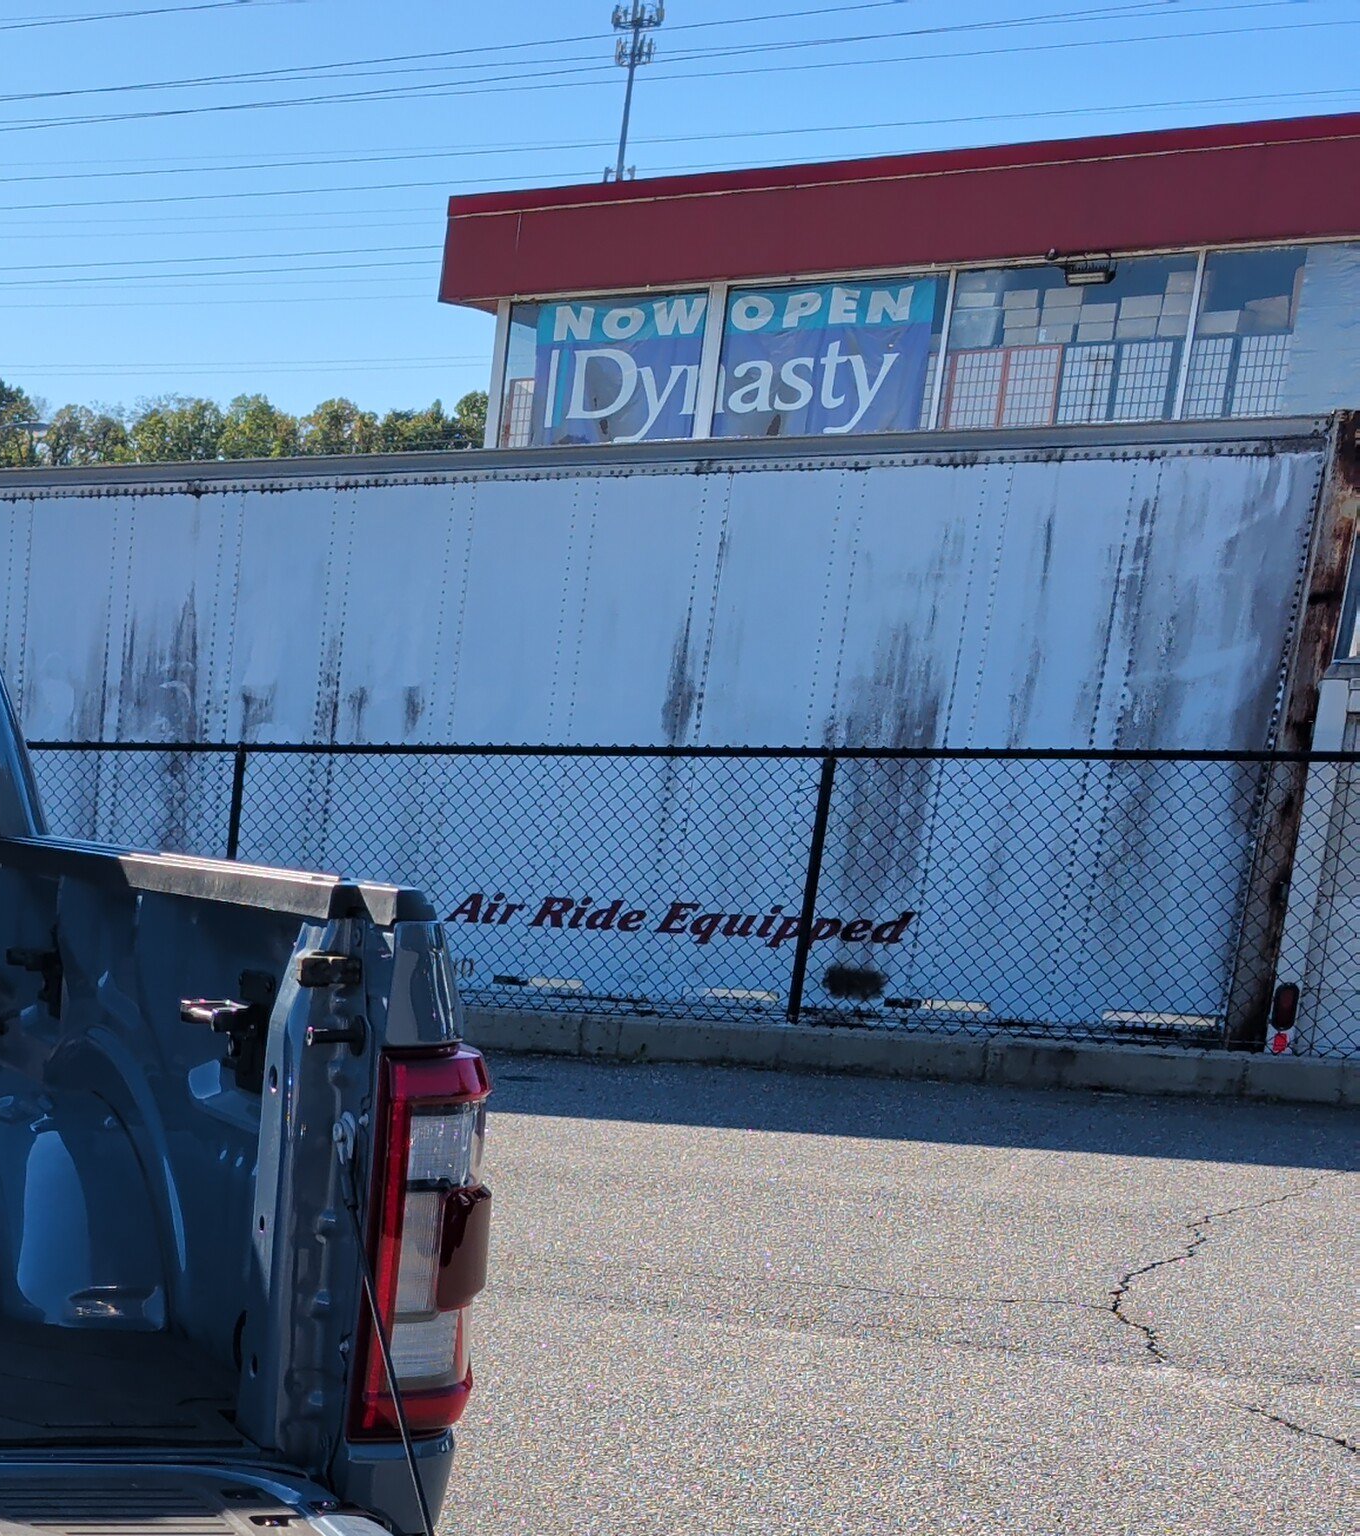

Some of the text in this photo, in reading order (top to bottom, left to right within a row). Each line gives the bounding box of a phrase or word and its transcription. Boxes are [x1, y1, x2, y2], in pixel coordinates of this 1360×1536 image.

[553, 286, 915, 341] NOW OPEN
[565, 341, 900, 443] Dynasty
[444, 892, 916, 948] Air Ride Equipped
